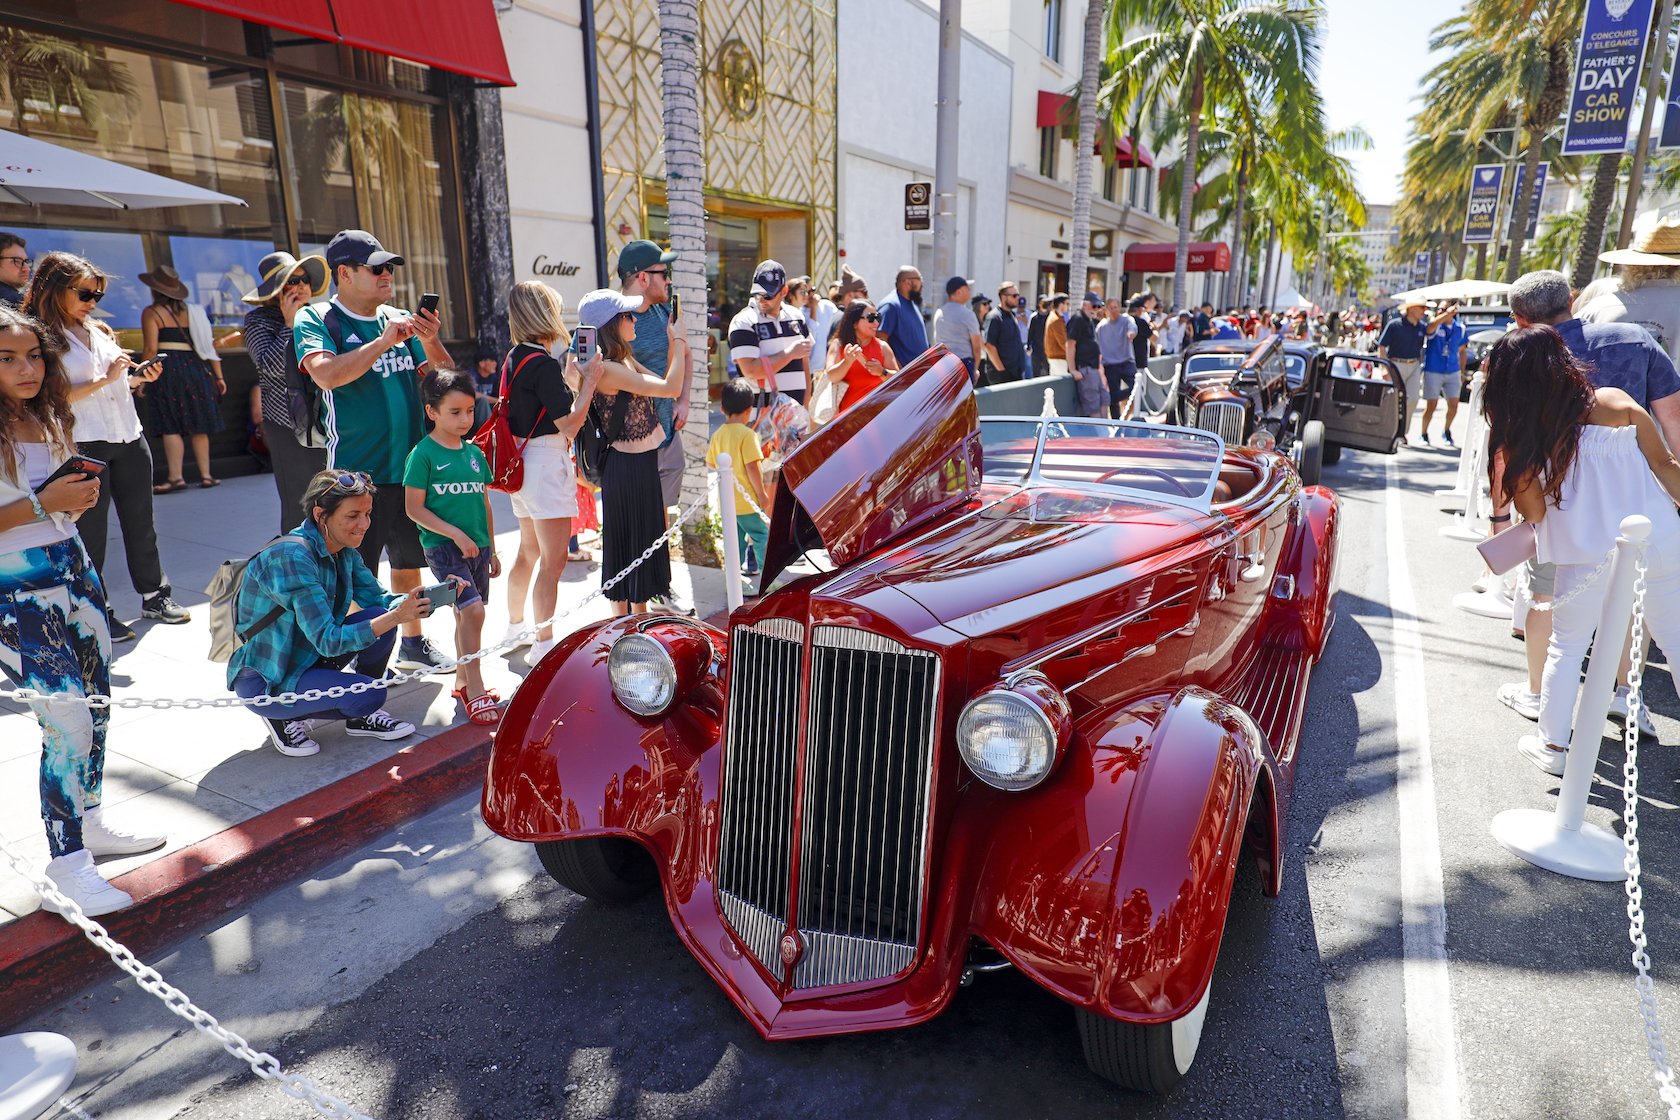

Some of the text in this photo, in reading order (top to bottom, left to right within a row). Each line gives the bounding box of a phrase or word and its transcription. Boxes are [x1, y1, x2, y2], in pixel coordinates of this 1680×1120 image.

[1591, 29, 1638, 40] CONCOURS
[1586, 38, 1640, 50] D'ELEGANCE
[1583, 55, 1636, 69] FATHER'S
[1579, 66, 1633, 91] DAY
[1585, 92, 1619, 107] CAR
[1574, 107, 1626, 123] SHOW
[1568, 136, 1624, 146] #ONLYONRODEO
[1470, 202, 1495, 214] DAY
[533, 254, 581, 276] Cartier
[1190, 254, 1205, 264] 360
[471, 697, 496, 712] FILA
